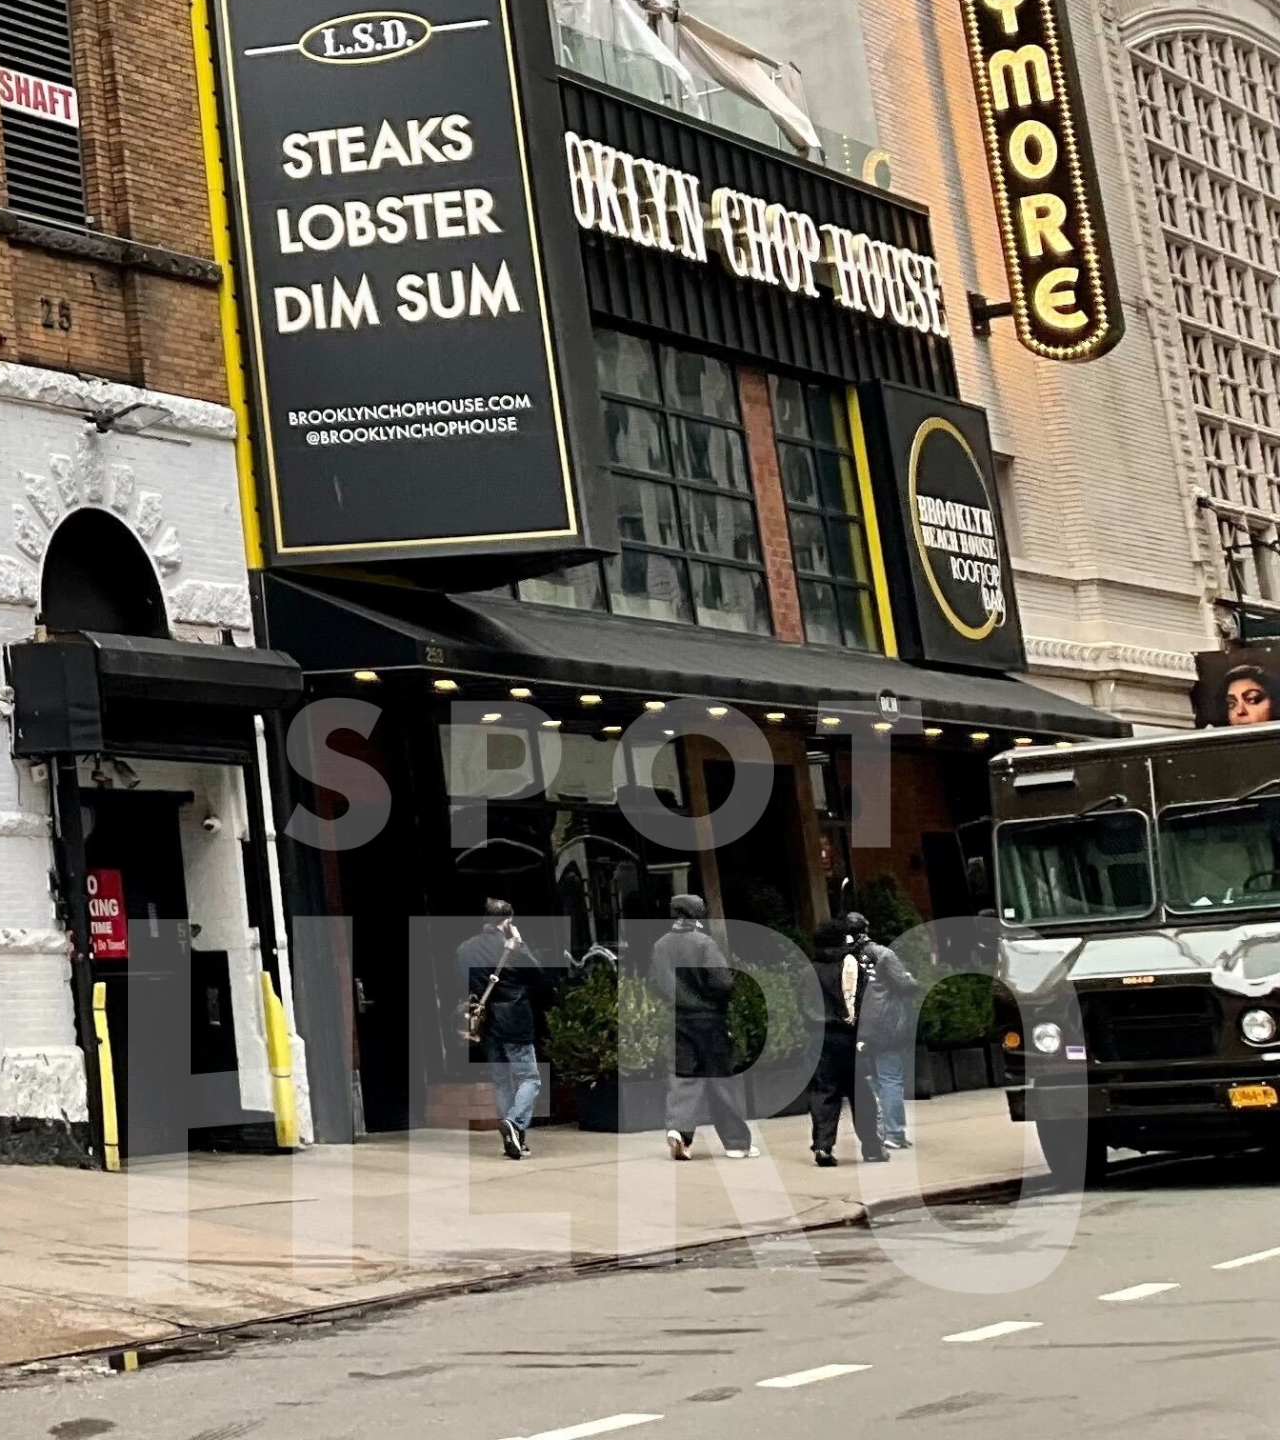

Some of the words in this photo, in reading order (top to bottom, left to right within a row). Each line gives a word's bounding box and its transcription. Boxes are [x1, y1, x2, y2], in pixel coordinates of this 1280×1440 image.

[320, 18, 415, 58] L.S.D.
[282, 113, 473, 180] STEAKS
[276, 188, 503, 254] LOBSTER
[565, 131, 708, 263] OKLYN
[711, 187, 820, 298] CHOP
[820, 224, 949, 338] HOUSE
[274, 272, 380, 334] DIM
[396, 259, 521, 323] SUM
[288, 393, 532, 426] BROOKLYNCHOPHOUSE.COM
[306, 416, 518, 446] @BROOKLYNCHOPHOUSE
[916, 495, 994, 537] BROOKLYN
[959, 532, 998, 560] HOUSE
[950, 555, 1000, 587] ROOFTOP
[87, 875, 97, 895] O
[89, 898, 119, 917] KING
